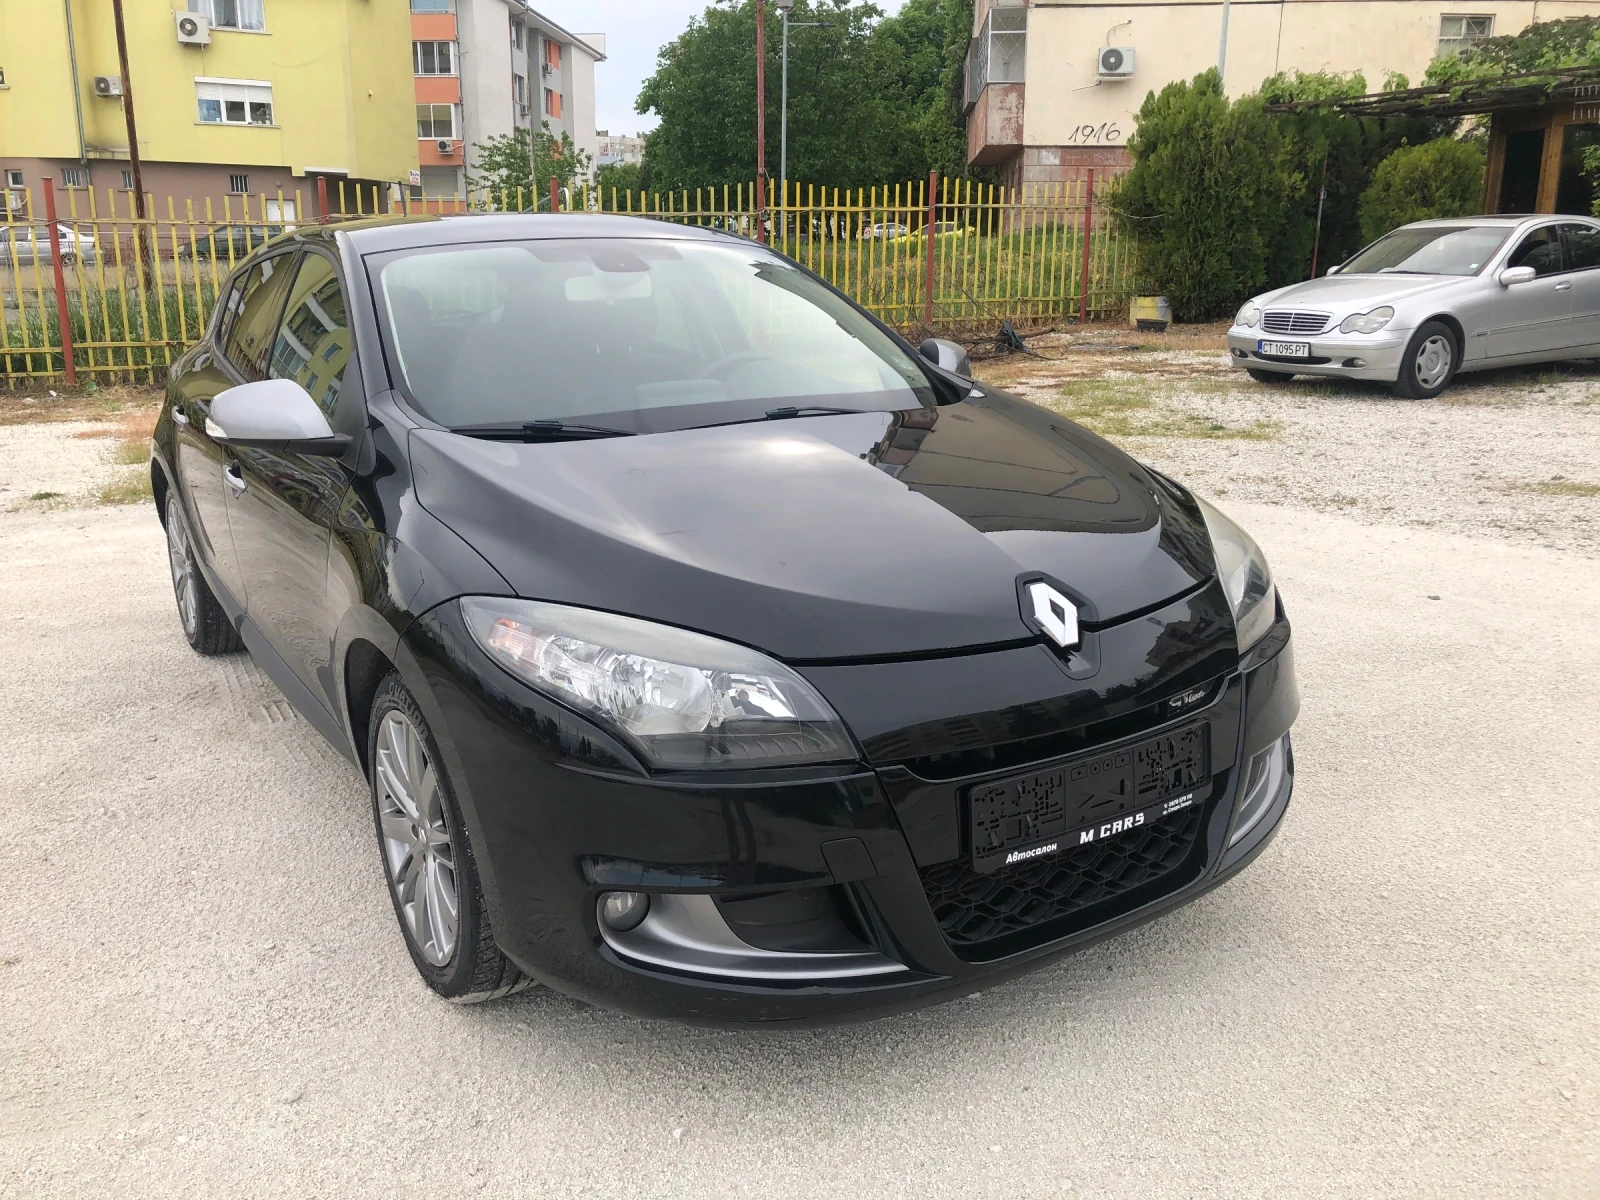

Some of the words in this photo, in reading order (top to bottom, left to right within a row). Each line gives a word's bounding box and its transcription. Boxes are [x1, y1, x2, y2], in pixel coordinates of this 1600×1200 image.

[1068, 122, 1120, 144] 1916
[1263, 343, 1273, 353] CT
[1275, 344, 1294, 355] 1095
[1295, 345, 1307, 356] PT
[1079, 828, 1095, 845] M
[1099, 812, 1145, 839] CARS
[1005, 843, 1058, 864] Автосалон
